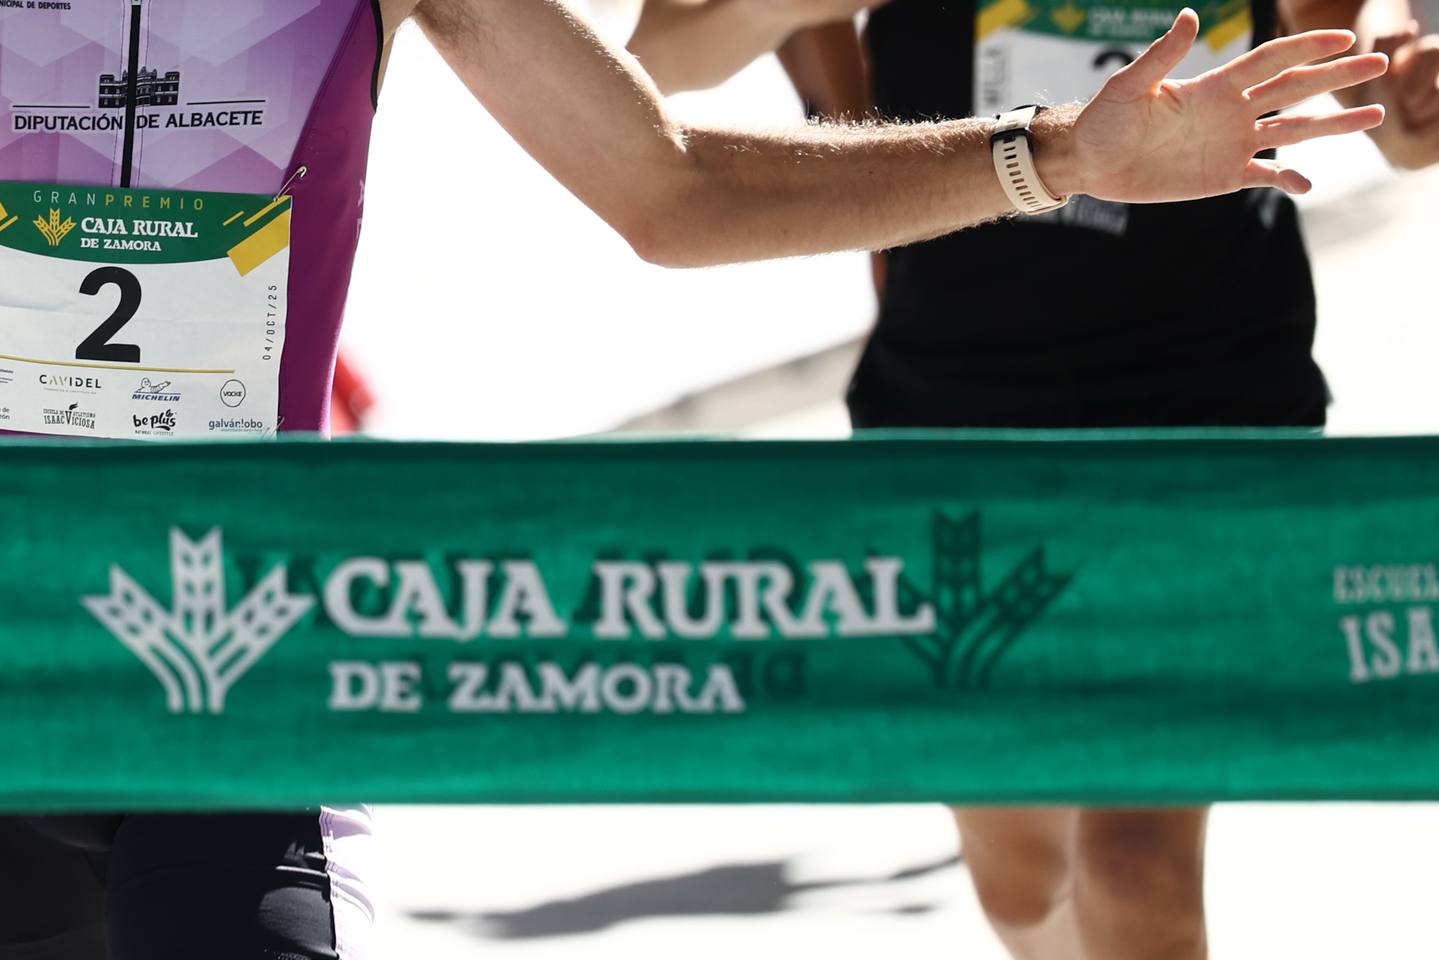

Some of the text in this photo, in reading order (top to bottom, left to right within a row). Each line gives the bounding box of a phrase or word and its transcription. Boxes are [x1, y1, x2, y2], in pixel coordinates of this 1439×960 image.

[27, 0, 35, 9] DE
[38, 1, 72, 10] DEPORTES
[13, 109, 263, 131] DIPUTACIÓN DE ALBACETE
[80, 217, 198, 238] CAJA RURAL
[80, 237, 162, 251] DE ZAMORA
[75, 266, 142, 363] 2
[39, 374, 102, 389] CAVIDEL
[132, 393, 181, 402] MICHELIN
[2, 405, 10, 413] de
[44, 410, 95, 429] ISAAC VICIOSA
[133, 414, 148, 427] be
[323, 555, 937, 642] CAJA RURAL
[327, 660, 422, 712] DE
[447, 661, 746, 715] ZAMORA
